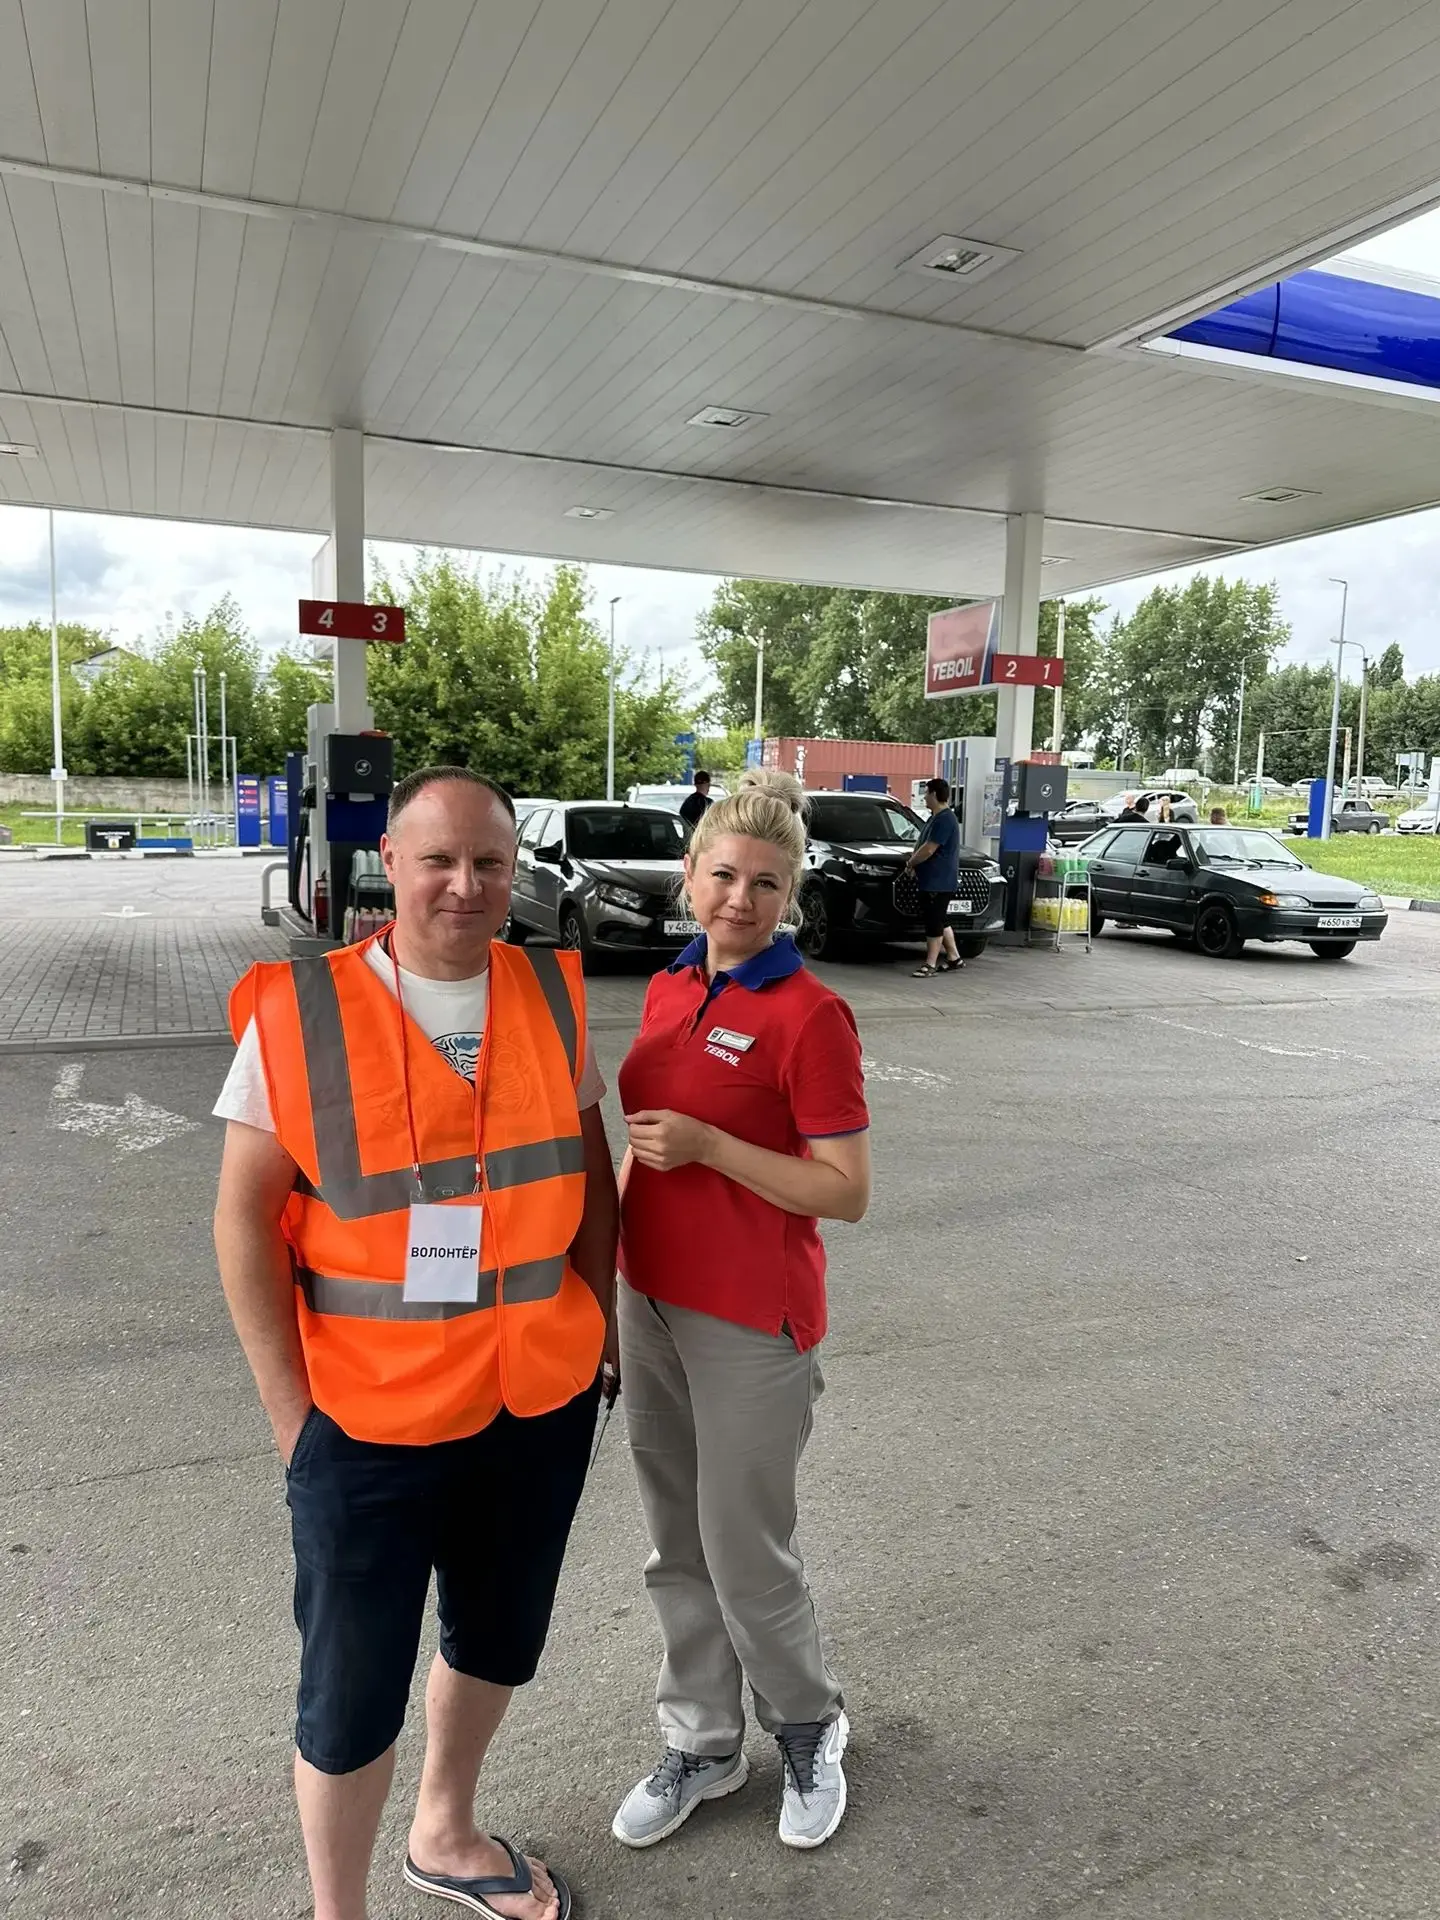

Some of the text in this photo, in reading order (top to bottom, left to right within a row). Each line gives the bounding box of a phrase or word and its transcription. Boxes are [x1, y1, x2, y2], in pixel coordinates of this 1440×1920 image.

[318, 608, 388, 633] 4 3
[932, 656, 975, 682] TEBOIL
[1005, 660, 1051, 680] 2 1
[703, 1043, 741, 1067] TEBOIL
[411, 1245, 478, 1259] ВОЛОНТЁР
